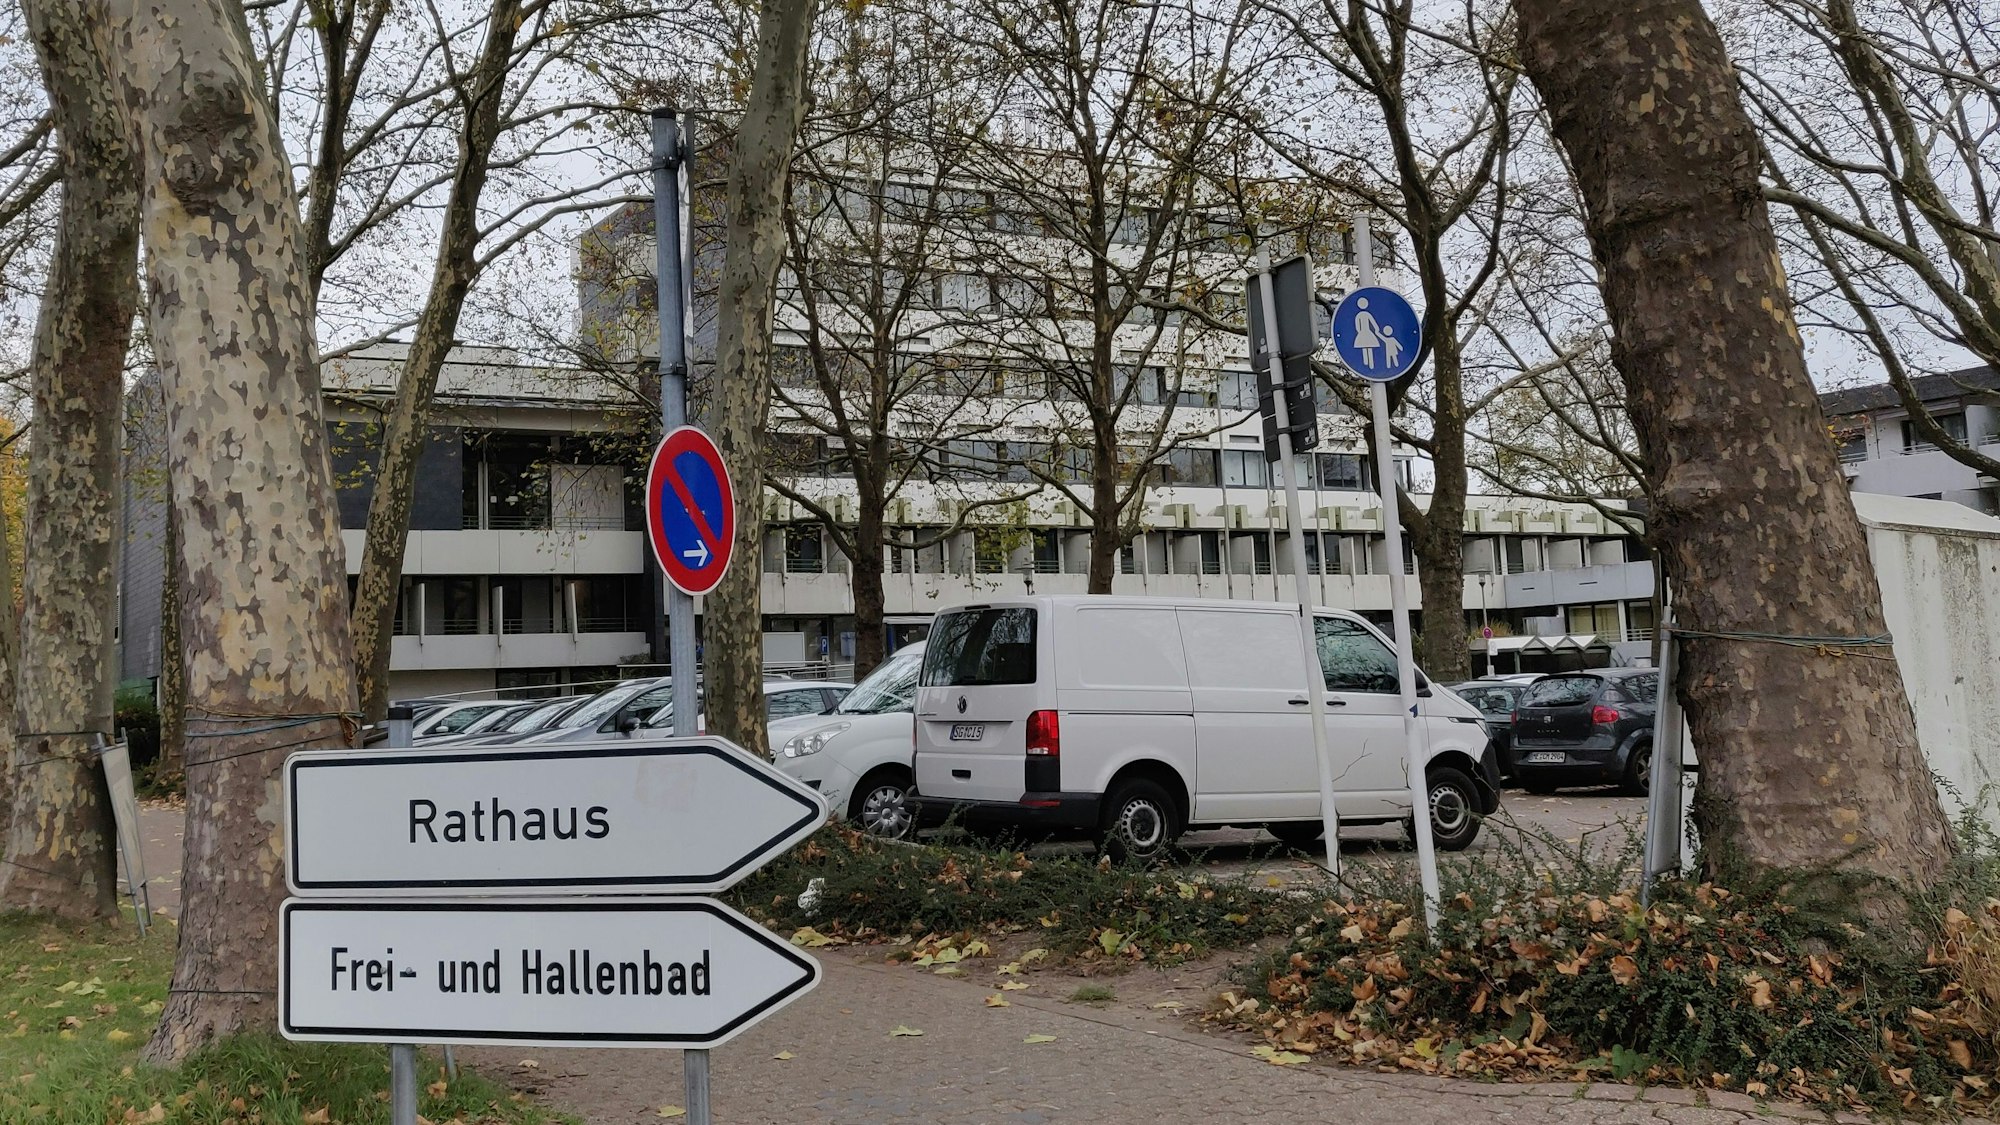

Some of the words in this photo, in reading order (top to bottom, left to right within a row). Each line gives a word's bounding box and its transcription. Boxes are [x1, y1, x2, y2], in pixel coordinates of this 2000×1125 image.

[409, 797, 610, 843] Rathaus
[331, 946, 417, 992] Frei-
[438, 948, 500, 994] und
[522, 948, 711, 996] Hallenbad
